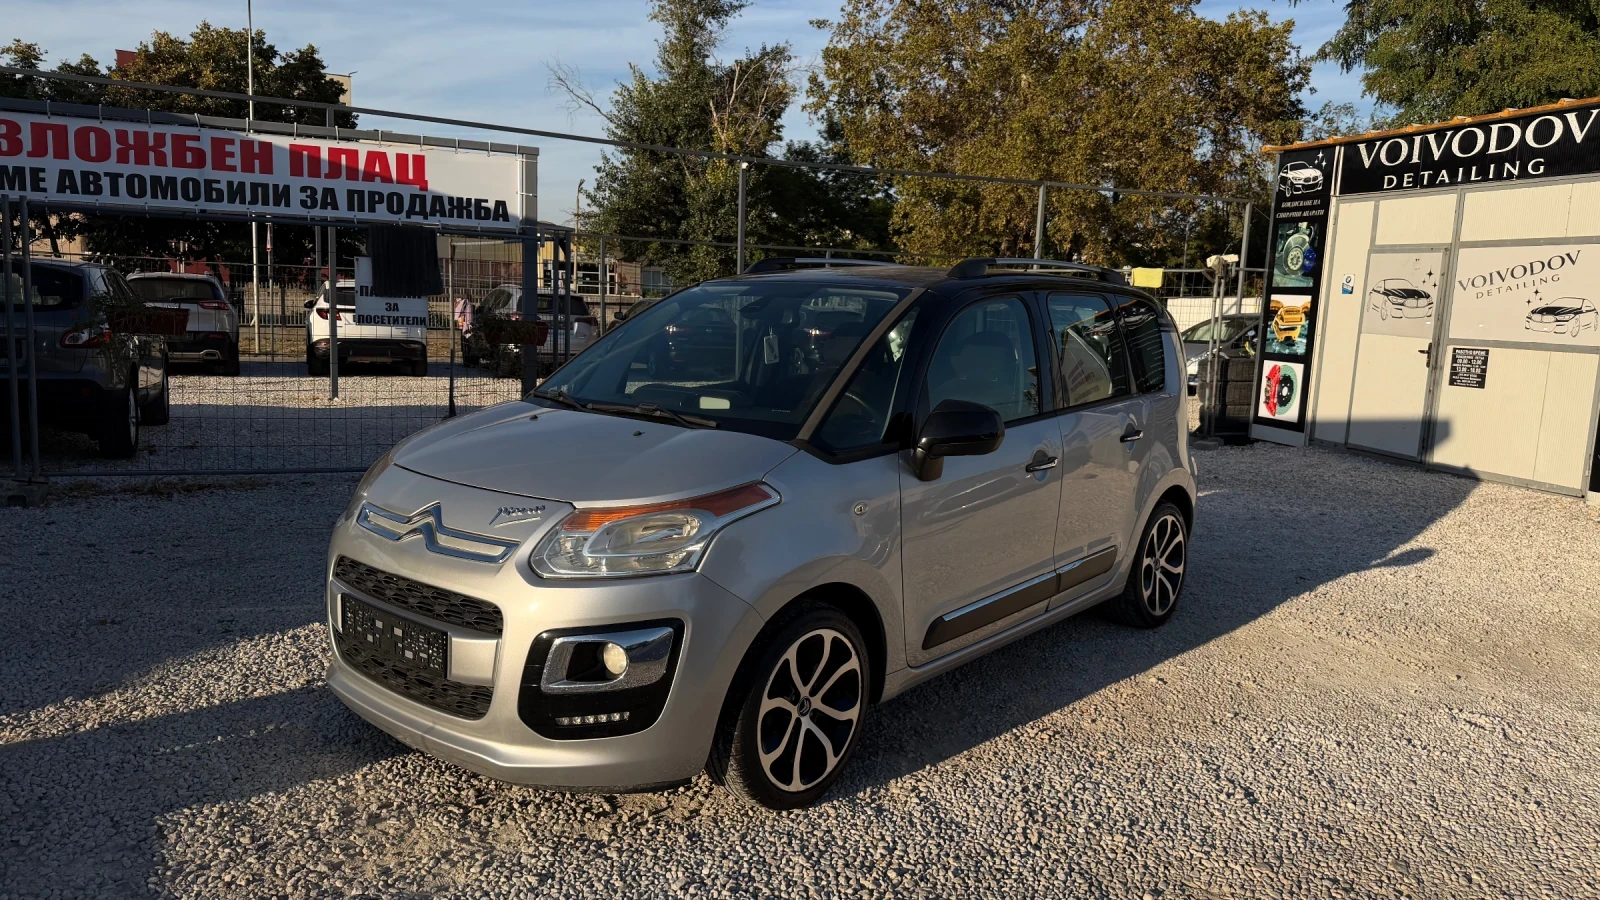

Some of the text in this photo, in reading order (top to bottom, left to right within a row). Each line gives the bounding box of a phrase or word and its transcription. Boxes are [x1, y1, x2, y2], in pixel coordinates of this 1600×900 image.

[1357, 109, 1600, 169] VOIVODOV
[289, 144, 429, 192] ПЛАЦ
[1383, 158, 1546, 189] DETAILING
[56, 168, 291, 208] АВТОМОБИЛИ
[300, 185, 339, 211] ЗА
[346, 188, 510, 223] ПРОДАЖБА
[1457, 250, 1581, 292] VOIVODOV
[1476, 274, 1560, 299] DETAILING
[357, 314, 427, 326] ПОСЕТИТЕЛИ
[385, 302, 399, 312] ЗА
